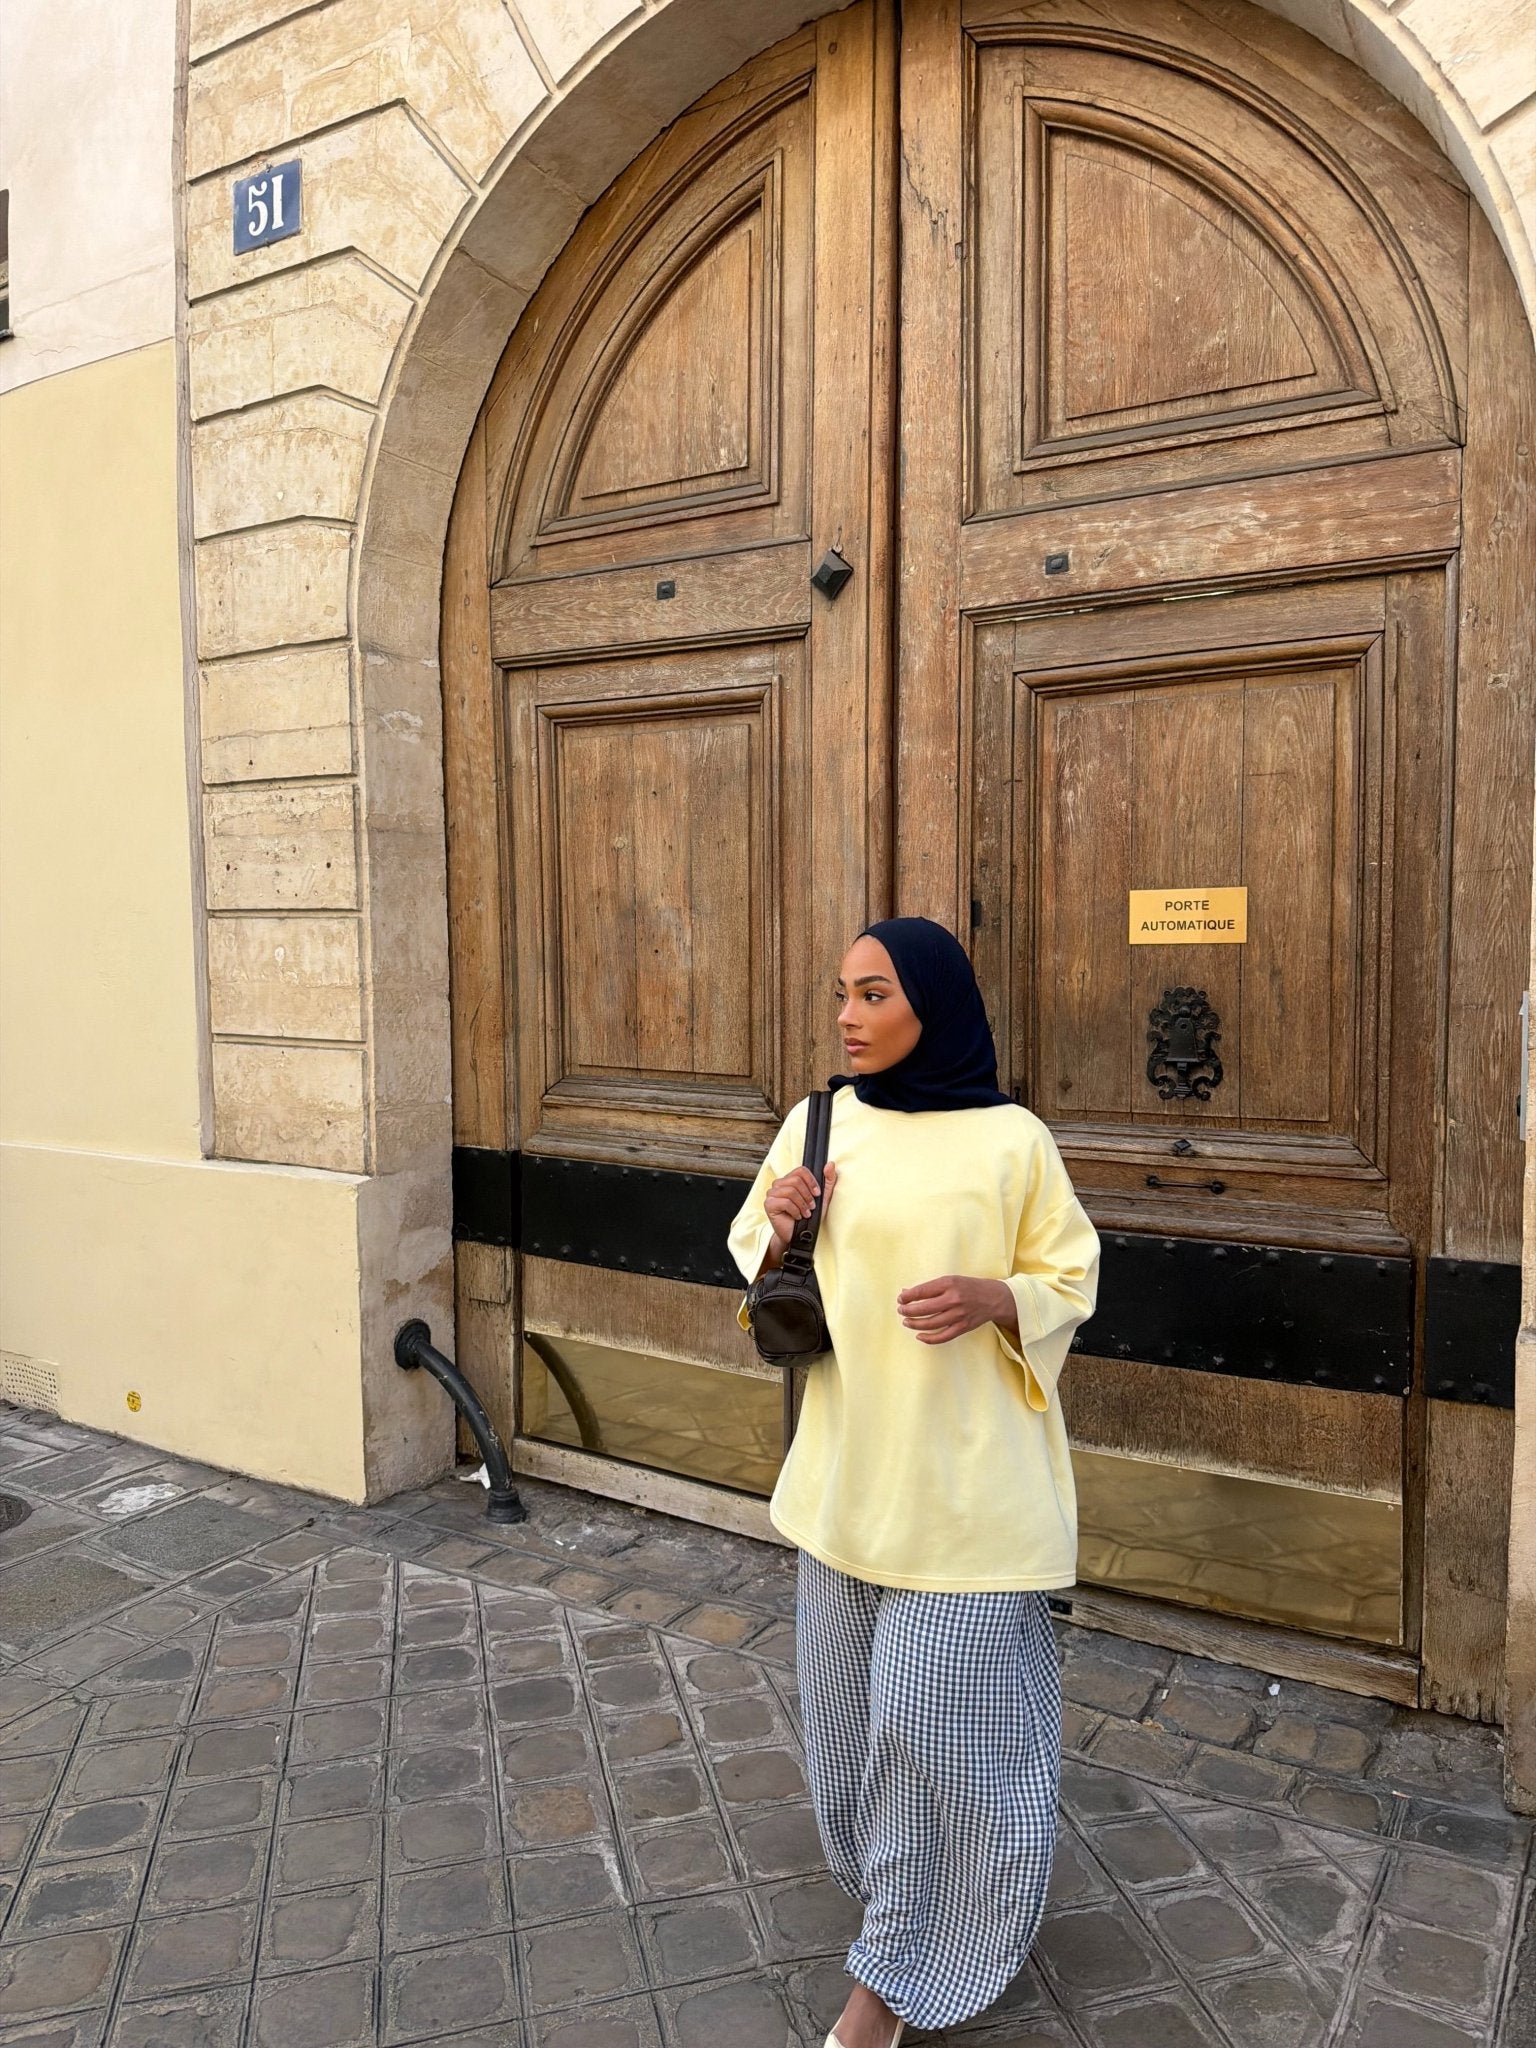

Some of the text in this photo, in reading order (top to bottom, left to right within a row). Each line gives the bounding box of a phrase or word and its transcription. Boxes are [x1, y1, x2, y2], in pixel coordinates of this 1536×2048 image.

[248, 174, 284, 236] 51
[1165, 900, 1210, 911] PORTE
[1140, 919, 1235, 931] AUTOMATIQUE
